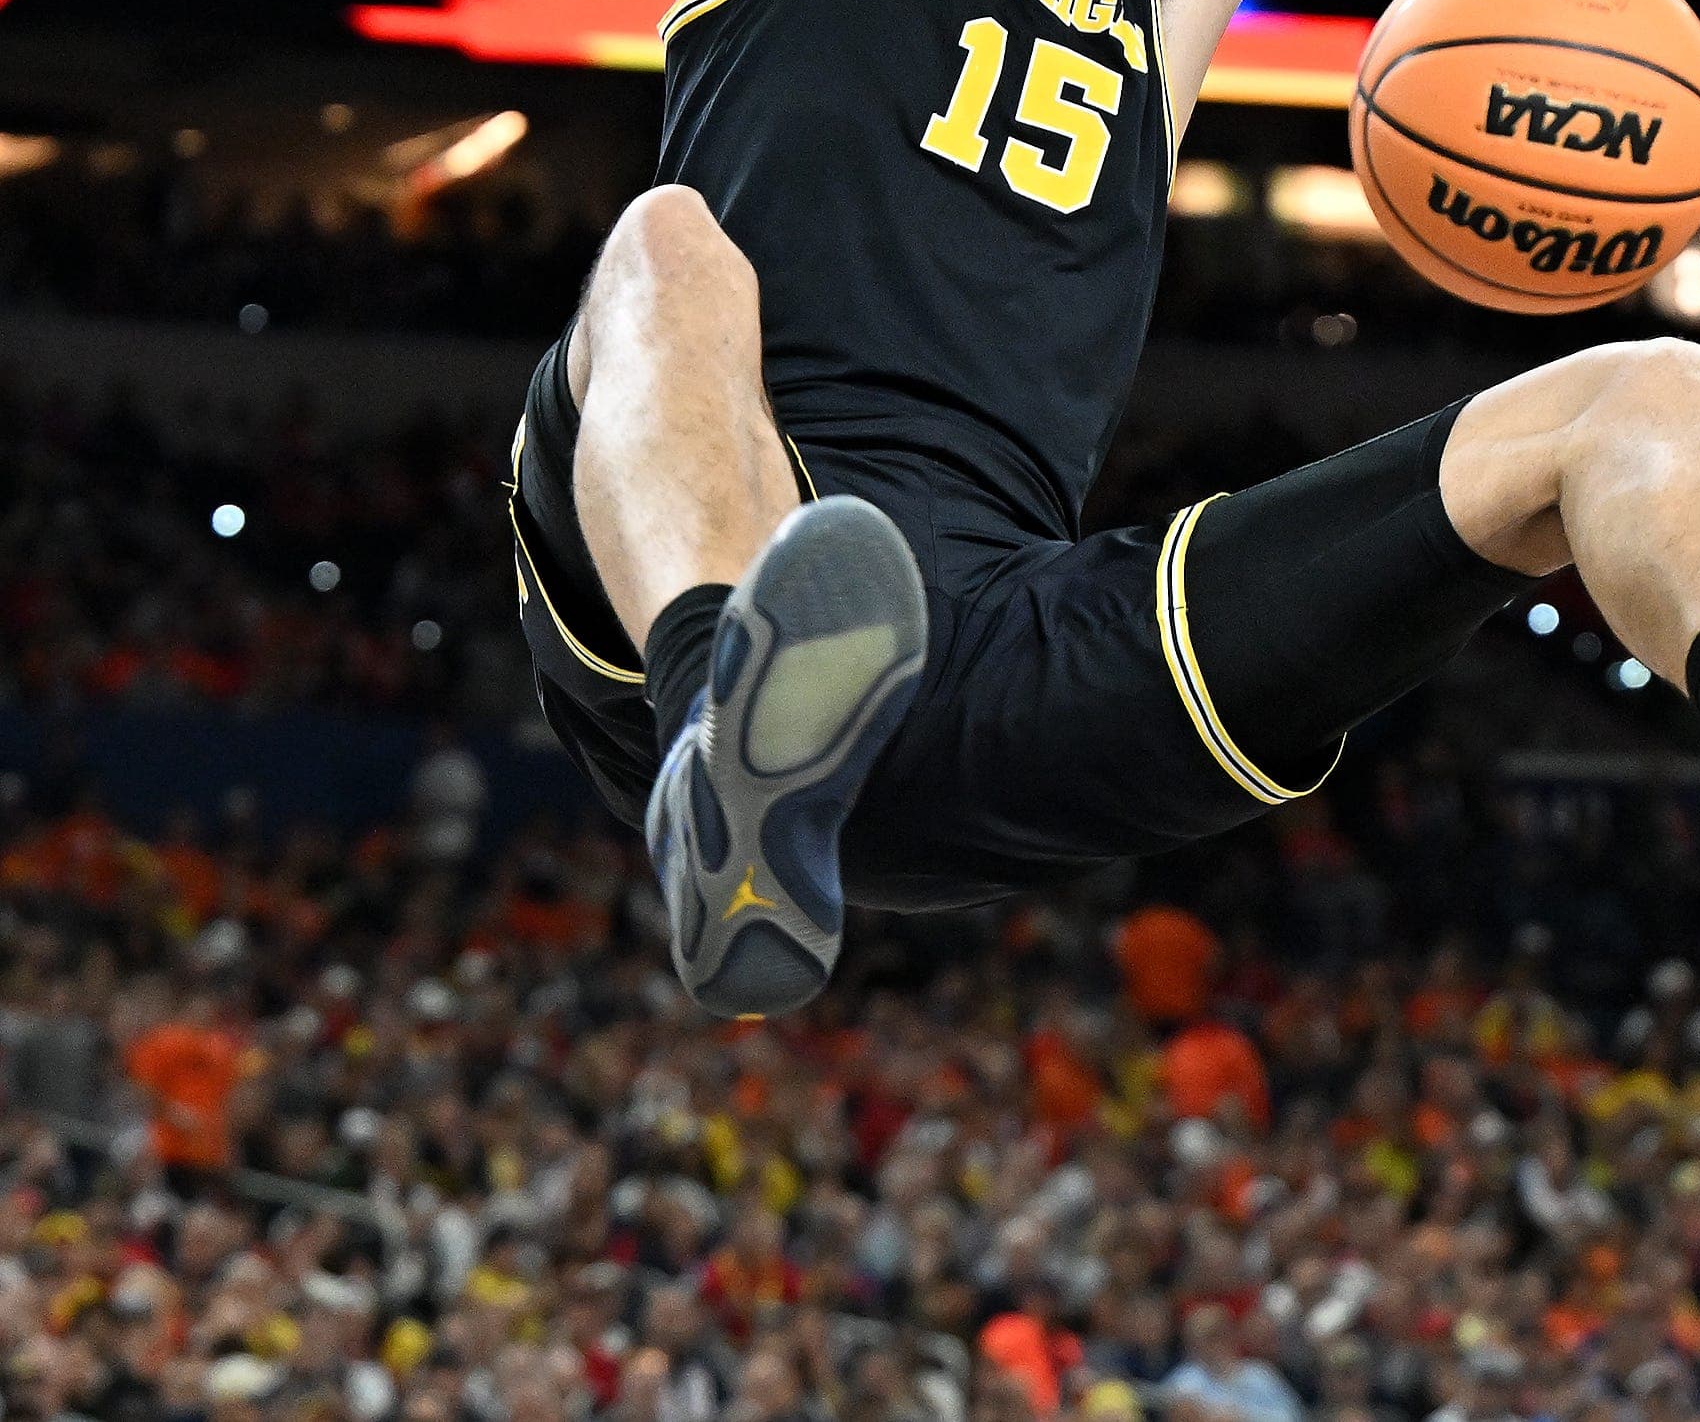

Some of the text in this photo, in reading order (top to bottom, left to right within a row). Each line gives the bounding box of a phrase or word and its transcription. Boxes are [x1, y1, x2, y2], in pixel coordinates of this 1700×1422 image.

[920, 17, 1124, 214] 15
[1485, 84, 1663, 166] NCAA
[1428, 174, 1665, 276] Wilson
